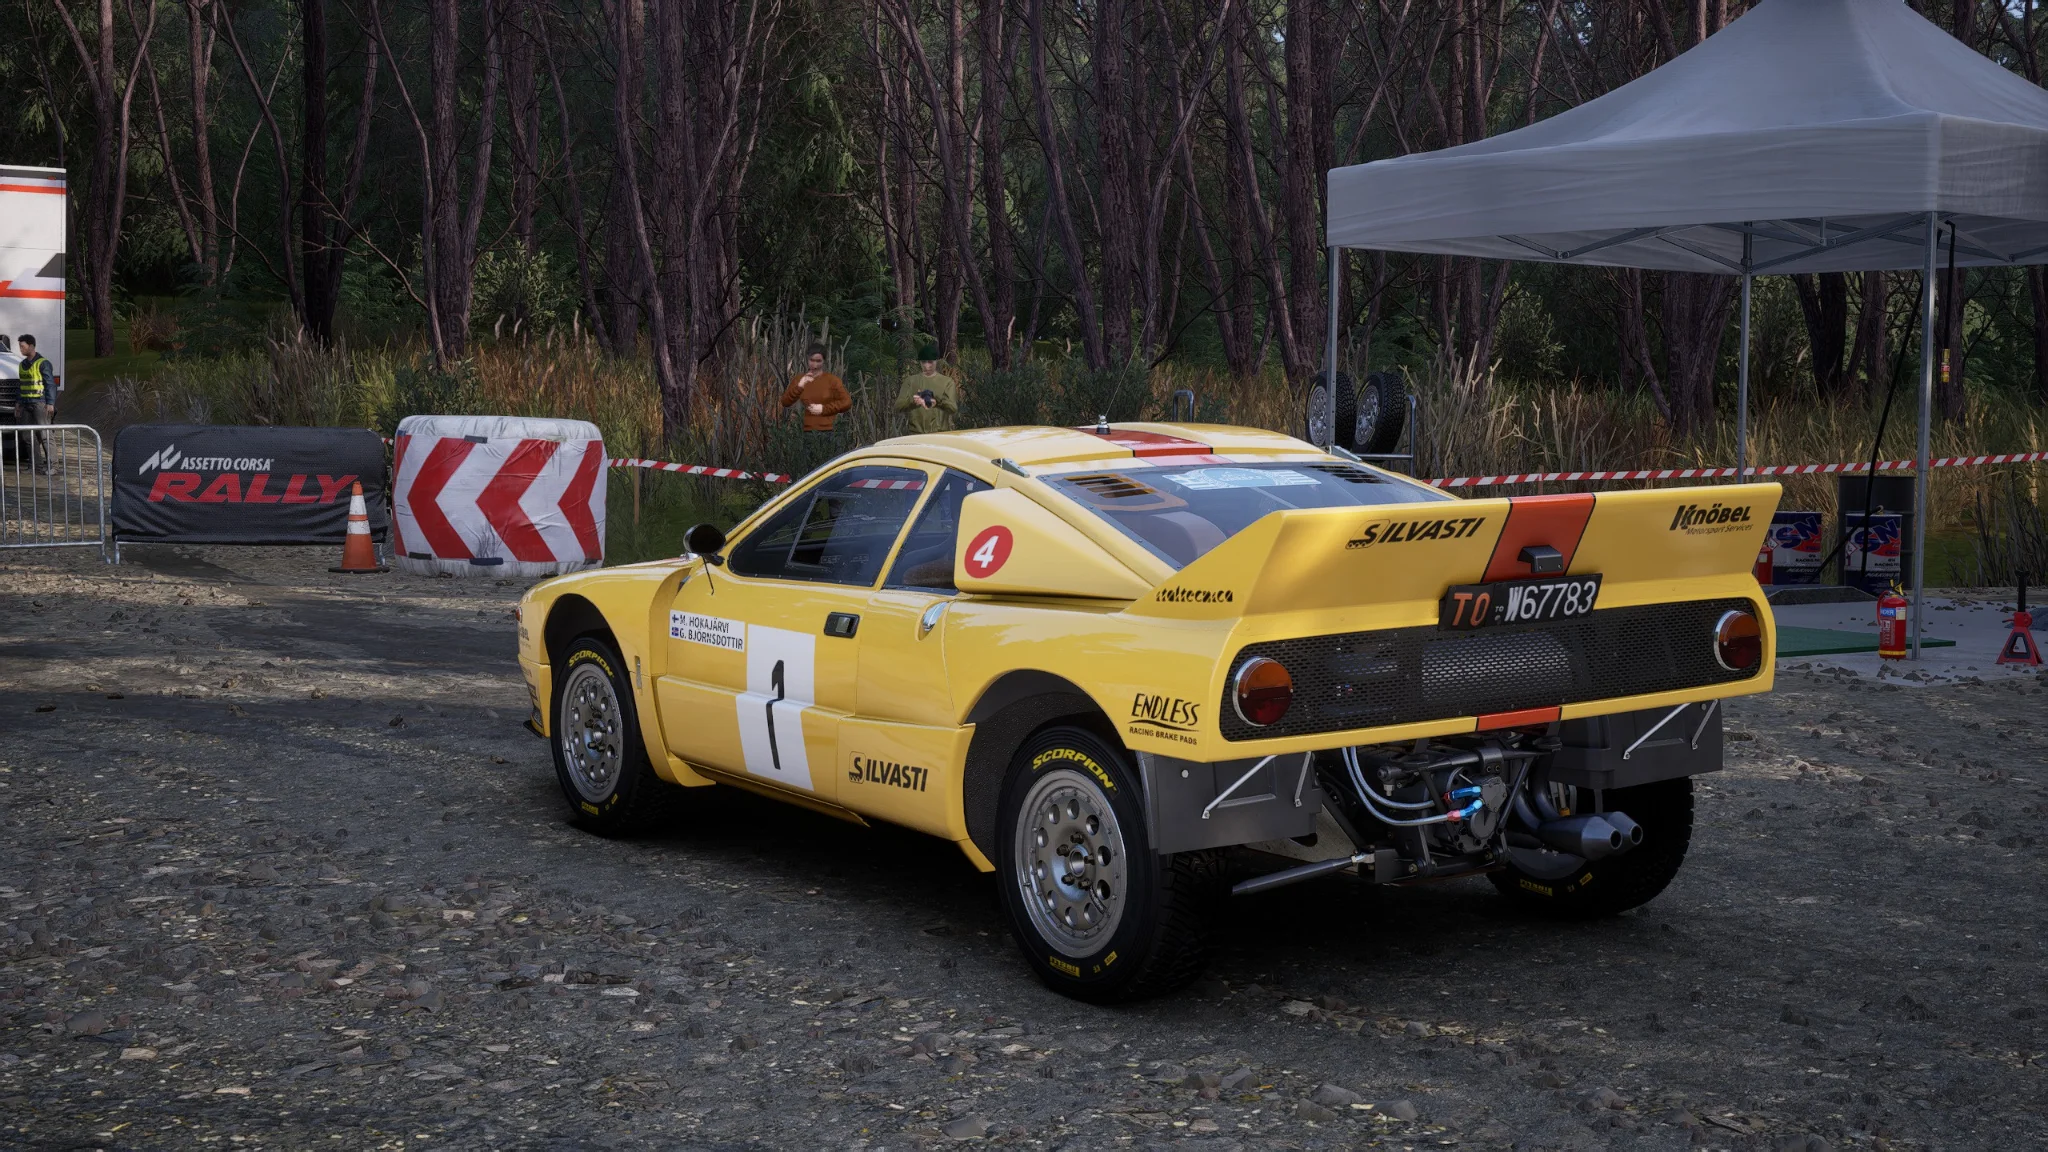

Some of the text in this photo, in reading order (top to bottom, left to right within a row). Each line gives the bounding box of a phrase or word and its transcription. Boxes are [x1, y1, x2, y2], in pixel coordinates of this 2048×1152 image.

[180, 457, 232, 471] ASSETTO
[148, 472, 360, 504] RALLY
[1347, 517, 1487, 548] SILVASTI
[1685, 524, 1754, 535] Motorsport Services
[973, 535, 999, 569] 4
[1452, 581, 1597, 627] TO W67783
[679, 614, 730, 634] M. HOKAJÄRVI
[679, 627, 744, 650] G. BJÖRNSDOTTIR
[568, 650, 613, 677] SCORPION
[766, 659, 785, 770] 1
[1131, 693, 1201, 726] ENDLESS
[1129, 726, 1198, 745] RACING BRAKE PADS
[849, 756, 929, 792] SILVASTI
[1032, 748, 1115, 790] SCORPION
